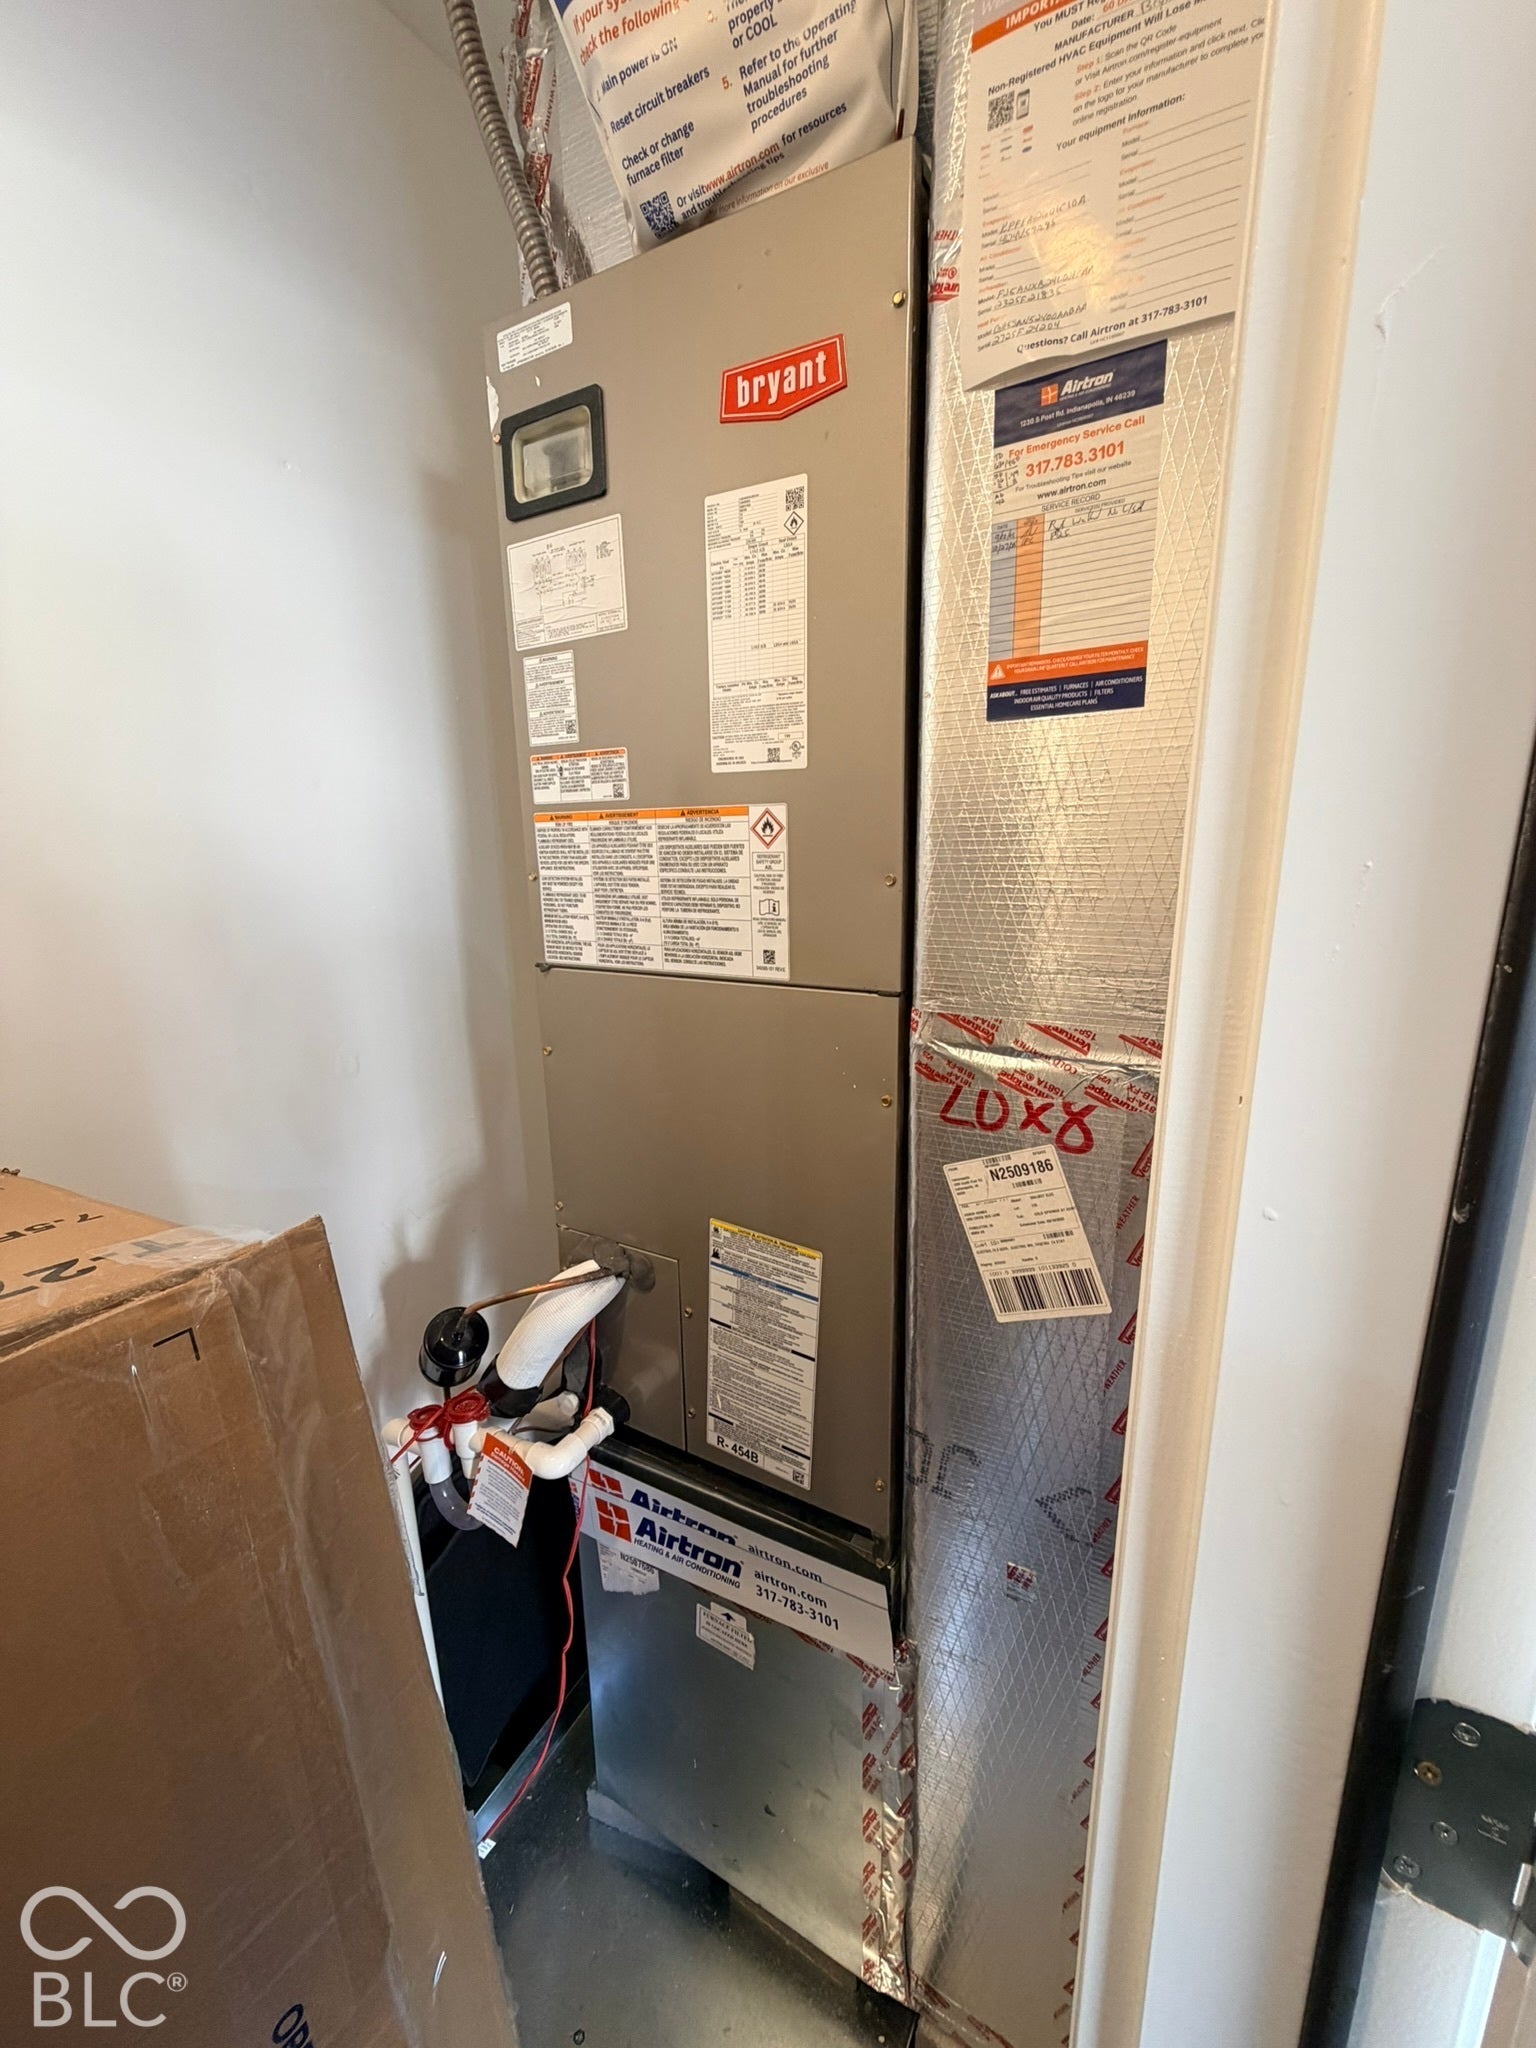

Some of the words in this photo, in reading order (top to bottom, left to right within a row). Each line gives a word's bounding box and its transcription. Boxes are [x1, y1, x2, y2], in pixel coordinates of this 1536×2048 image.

[579, 1, 603, 34] your
[727, 0, 774, 34] property
[732, 35, 744, 49] or
[745, 14, 779, 42] COOL
[1034, 17, 1053, 32] You
[1055, 3, 1084, 23] MUST
[1054, 9, 1135, 52] MANUFACTURER
[1071, 14, 1095, 31] Date:
[580, 33, 598, 67] check
[599, 25, 619, 44] the
[721, 75, 733, 91] 5.
[739, 55, 768, 80] Refer
[770, 46, 781, 62] to
[783, 36, 801, 53] the
[802, 0, 858, 40] Operating
[743, 66, 782, 97] Manual
[783, 55, 798, 75] for
[799, 30, 839, 63] further
[988, 58, 1056, 96] Non-Registered
[1058, 45, 1086, 66] HVAC
[1089, 20, 1142, 52] Equipment
[1144, 11, 1163, 28] Will
[1165, 1, 1191, 18] Lose
[1103, 74, 1123, 89] Enter
[1124, 67, 1143, 82] your
[1143, 48, 1188, 73] information
[1189, 41, 1206, 54] and
[1207, 30, 1226, 47] click
[1105, 47, 1125, 61] Scan
[1126, 40, 1139, 52] the
[1155, 24, 1178, 39] Code
[601, 73, 619, 96] Main
[619, 57, 649, 86] power
[661, 37, 678, 58] ON
[746, 53, 830, 114] troubleshooting
[1073, 105, 1083, 114] on
[1084, 98, 1096, 110] the
[1097, 91, 1114, 105] logo
[1127, 79, 1145, 94] your
[1146, 55, 1199, 84] manufacturer
[1200, 52, 1209, 63] to
[1210, 36, 1249, 61] complete
[610, 111, 634, 135] Reset
[635, 95, 665, 120] circuit
[667, 66, 710, 101] breakers
[751, 86, 808, 134] procedures
[1056, 137, 1077, 151] Your
[1078, 115, 1127, 143] equipment
[1127, 93, 1186, 123] Information:
[1095, 93, 1138, 117] registration
[621, 147, 649, 171] Check
[650, 139, 660, 154] or
[661, 120, 695, 149] change
[626, 161, 661, 187] furnace
[661, 145, 685, 168] filter
[676, 195, 687, 208] Or
[687, 183, 706, 203] visit
[704, 141, 780, 193] www.airtron.com
[781, 130, 796, 147] for
[798, 102, 848, 139] resources
[681, 205, 698, 220] and
[766, 151, 785, 169] tips
[798, 161, 829, 182] exclusive
[1017, 336, 1068, 354] Questions?
[1070, 330, 1088, 343] Call
[1090, 321, 1126, 338] Airtron
[1128, 317, 1139, 328] at
[1140, 295, 1208, 324] 317-783-3101
[736, 349, 827, 410] bryant
[1061, 371, 1114, 396] Airtron
[1008, 447, 1025, 459] For
[1026, 433, 1081, 456] Emergency
[1083, 423, 1122, 440] Service
[1124, 415, 1145, 429] Call
[1015, 484, 1025, 493] For
[1108, 459, 1133, 471] website
[1025, 440, 1125, 479] 317.783.3101
[1037, 478, 1107, 501] www.airtron.com
[1041, 498, 1071, 513] SERVICE
[1071, 492, 1101, 506] RECORD
[1052, 1058, 1078, 1075] COLD
[989, 1158, 1054, 1182] N2509186
[716, 1435, 729, 1448] R-
[731, 1443, 759, 1464] 454B
[630, 1489, 736, 1546] Airtron
[634, 1537, 664, 1557] HEATING
[665, 1551, 670, 1559] &
[671, 1553, 685, 1565] AIR
[685, 1559, 740, 1589] CONDITIONING
[635, 1517, 742, 1578] Airtron
[748, 1544, 822, 1584] airtron.com
[754, 1570, 827, 1609] airtron.com
[755, 1585, 840, 1631] 317-783-3101
